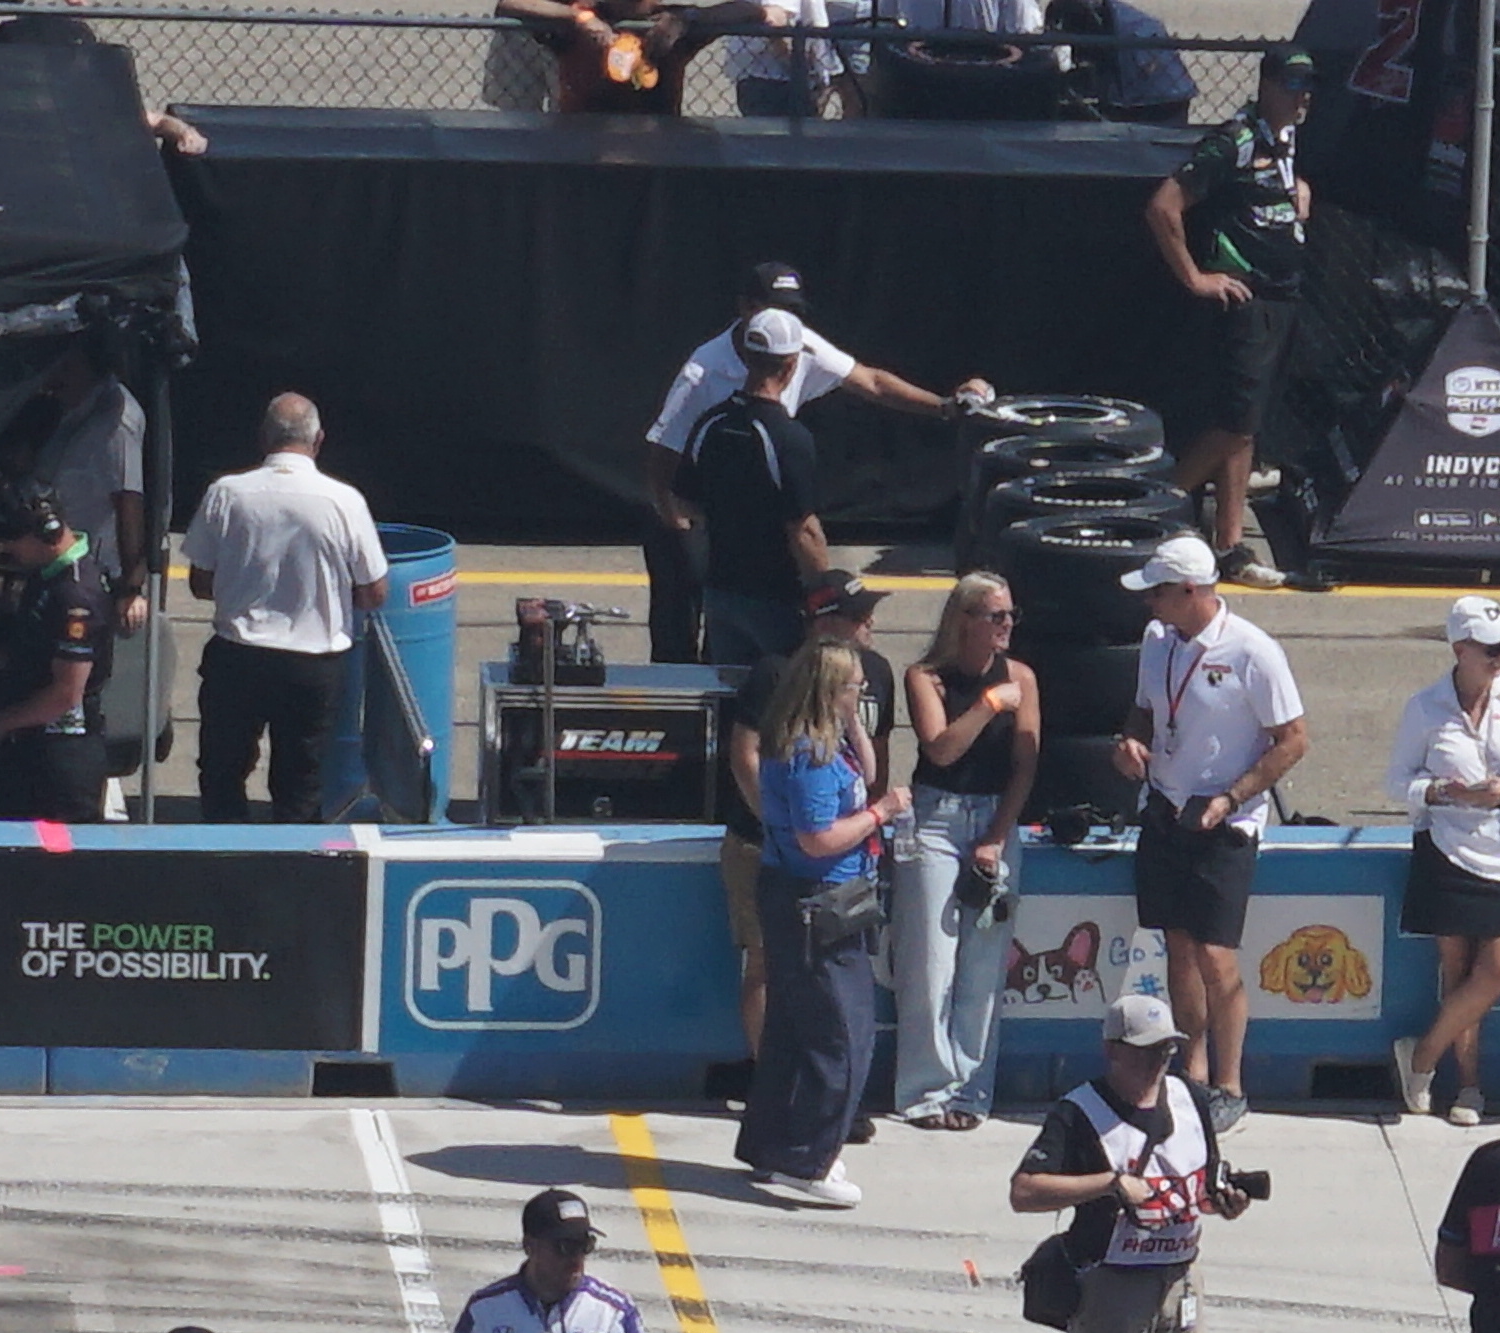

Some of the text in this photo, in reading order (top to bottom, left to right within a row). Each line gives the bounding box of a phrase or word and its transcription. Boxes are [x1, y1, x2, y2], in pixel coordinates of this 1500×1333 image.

[556, 728, 668, 752] TEAM
[22, 922, 214, 950] THE POWER
[22, 951, 271, 980] OF POSSIBILITY.
[418, 897, 587, 1013] PPG
